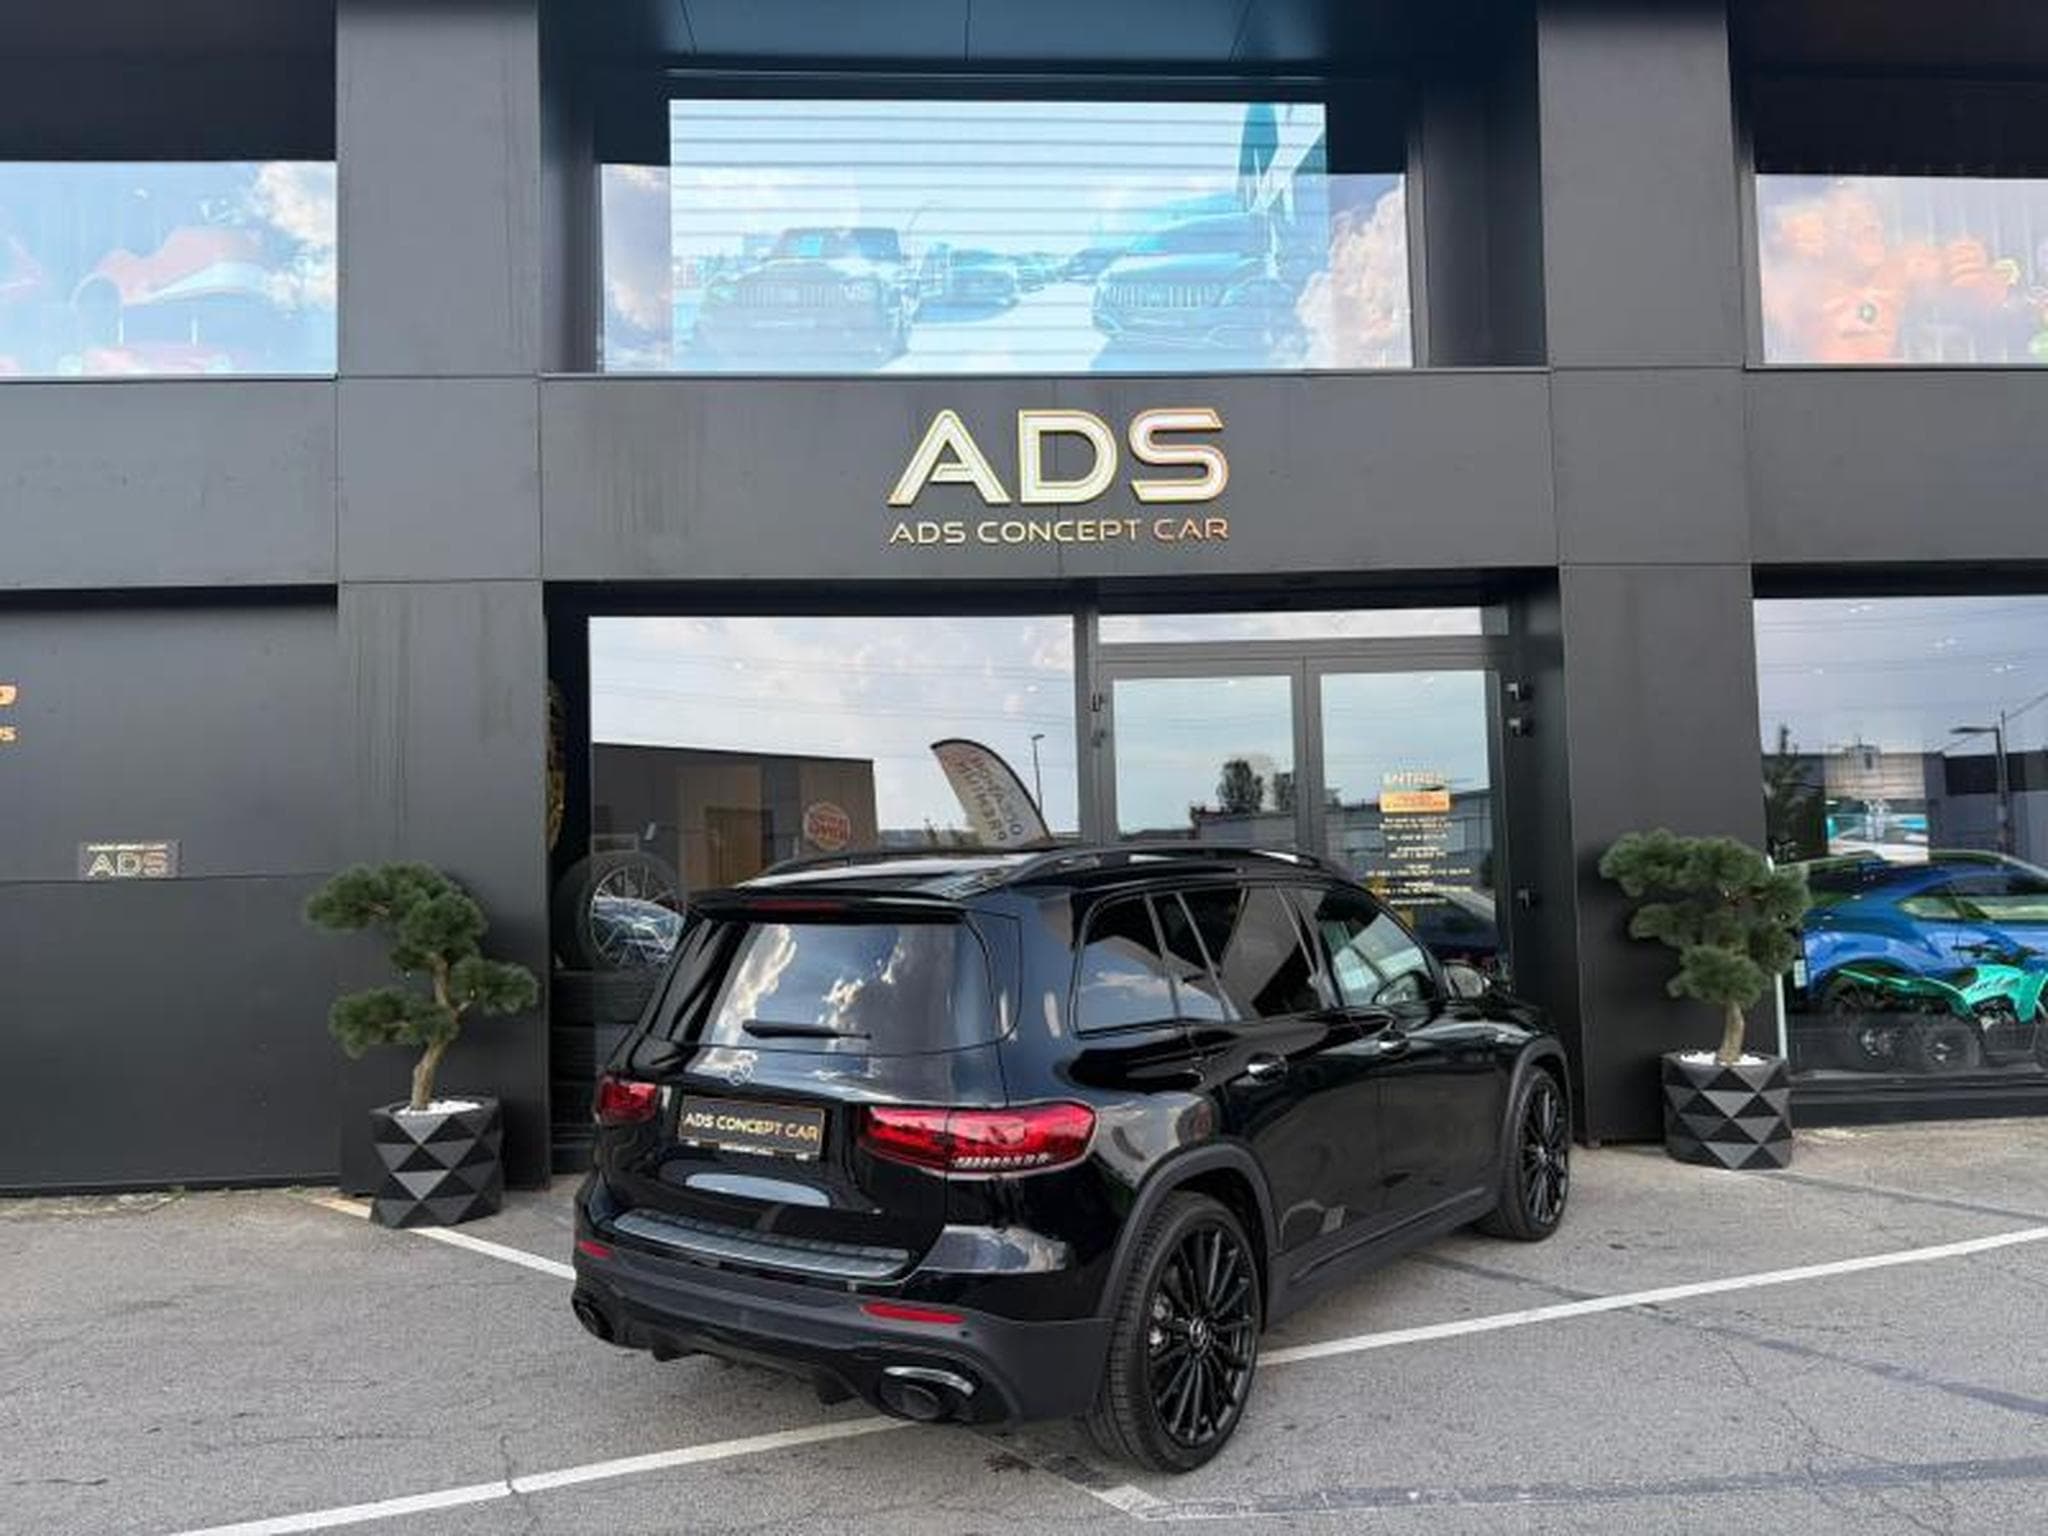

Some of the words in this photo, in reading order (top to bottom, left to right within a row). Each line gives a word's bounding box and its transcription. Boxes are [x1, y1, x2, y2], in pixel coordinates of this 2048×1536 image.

[887, 408, 1230, 505] ADS
[889, 521, 966, 544] ADS
[977, 519, 1141, 544] CONCEPT
[1153, 518, 1230, 540] CAR
[87, 852, 168, 877] ADS
[684, 1113, 715, 1128] ADS
[716, 1115, 783, 1136] CONCEPT
[786, 1123, 818, 1141] CAR
